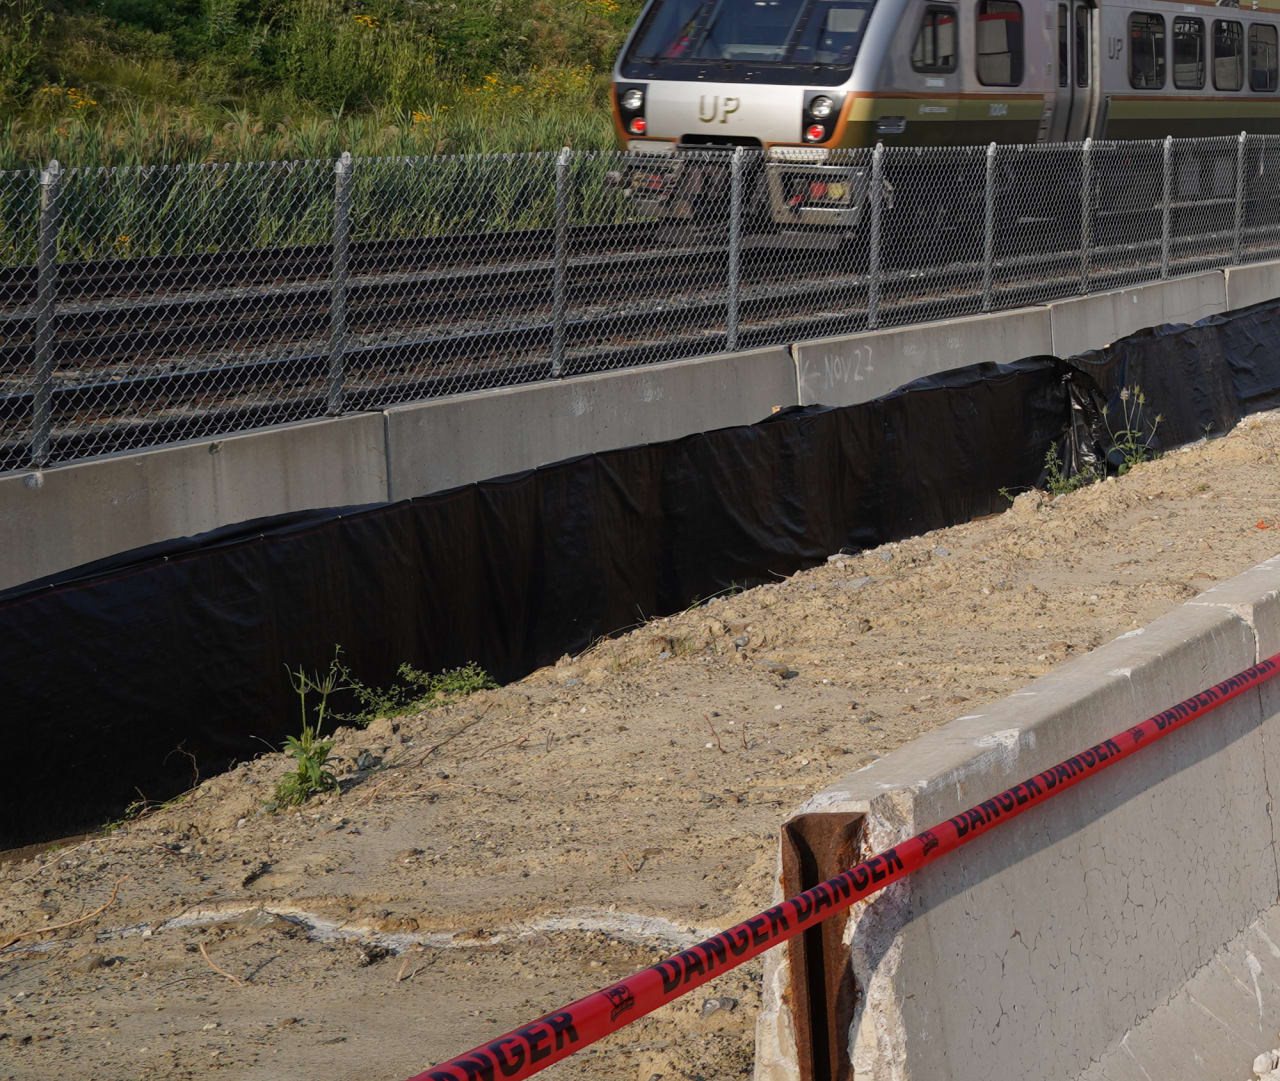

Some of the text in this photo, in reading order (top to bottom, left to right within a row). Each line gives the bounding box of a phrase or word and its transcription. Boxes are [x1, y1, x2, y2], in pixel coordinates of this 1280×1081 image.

[1108, 36, 1123, 60] UP
[698, 95, 741, 124] UP
[654, 905, 791, 994] DANGER
[790, 849, 904, 923] DANGER
